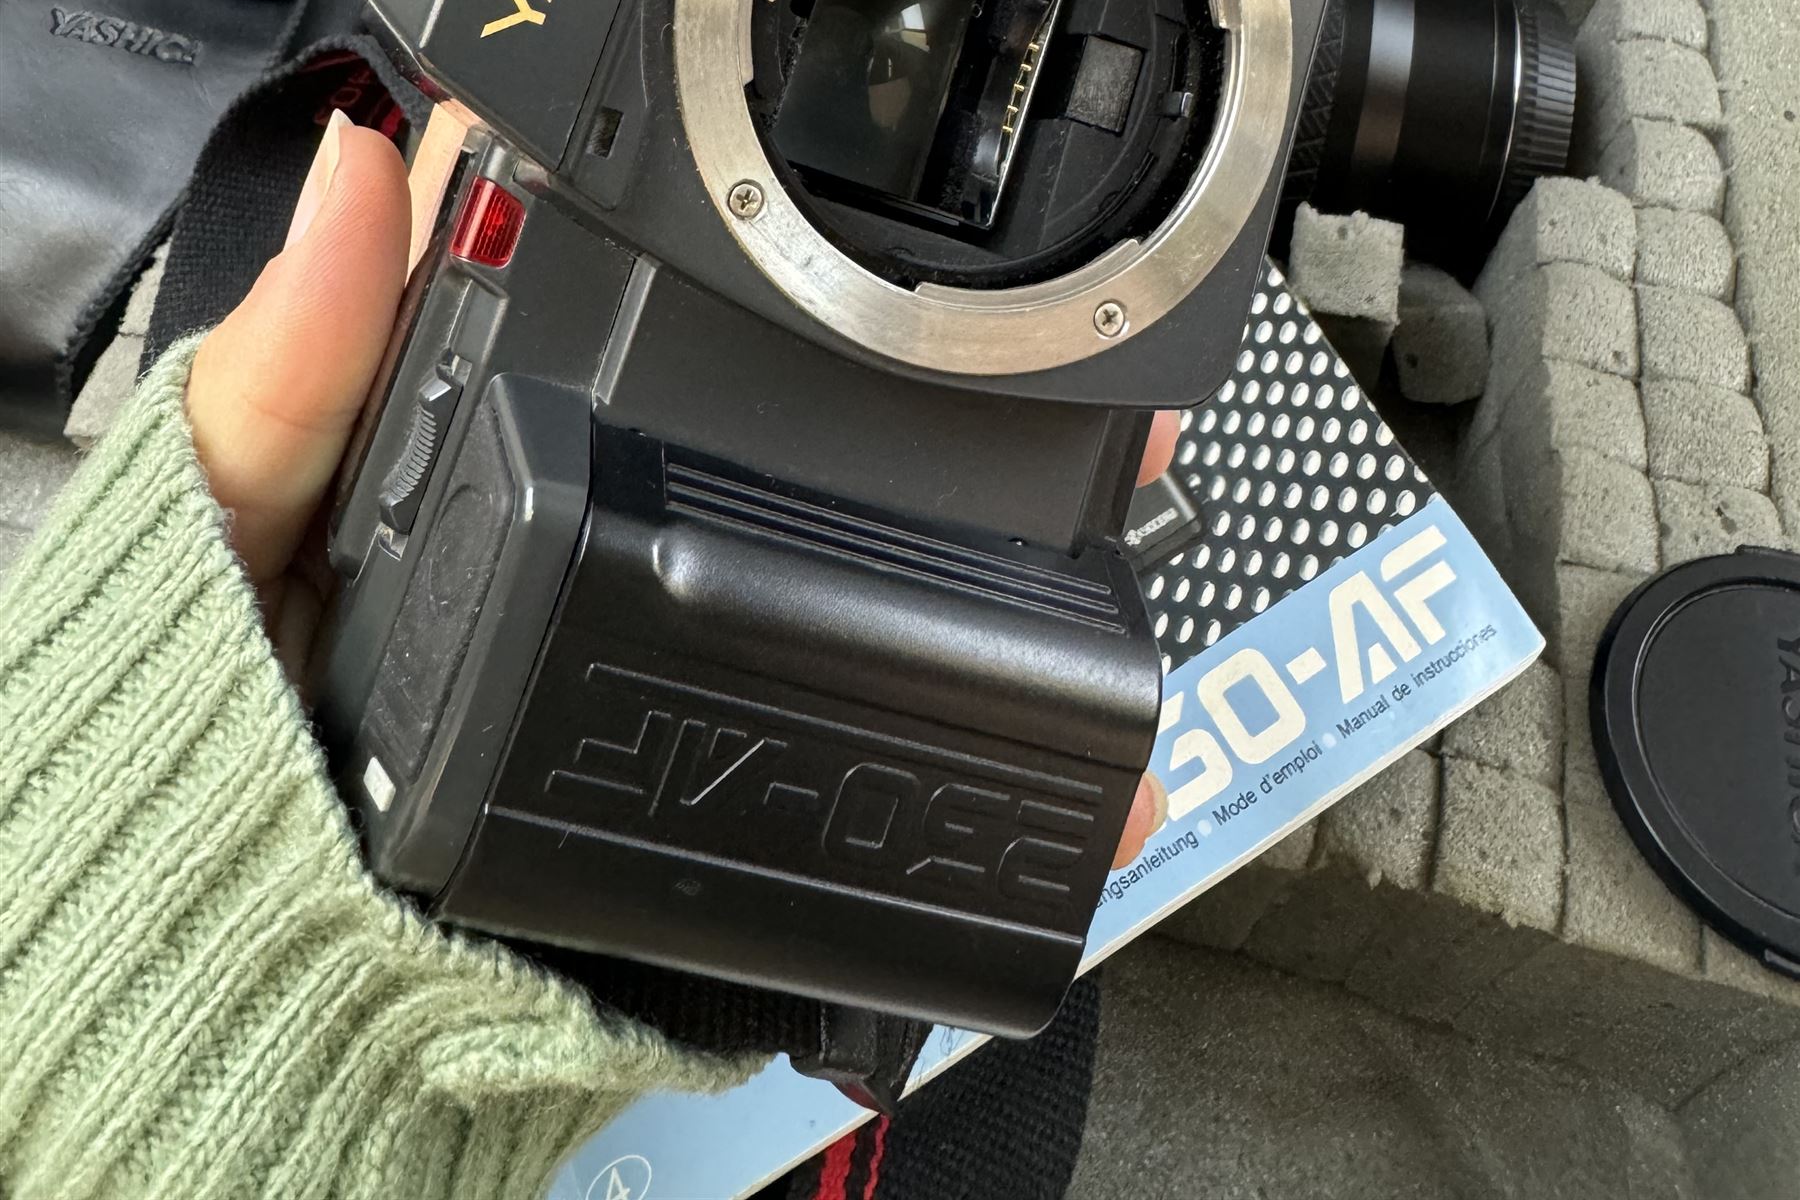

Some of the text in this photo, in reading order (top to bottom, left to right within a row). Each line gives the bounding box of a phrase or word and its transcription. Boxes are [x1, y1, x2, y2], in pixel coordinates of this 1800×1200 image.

[544, 709, 1095, 892] 230-AF
[1096, 624, 1498, 908] ngsanleitung Mode d'emploi Manual de instrucciones
[1156, 525, 1457, 822] 30-AF
